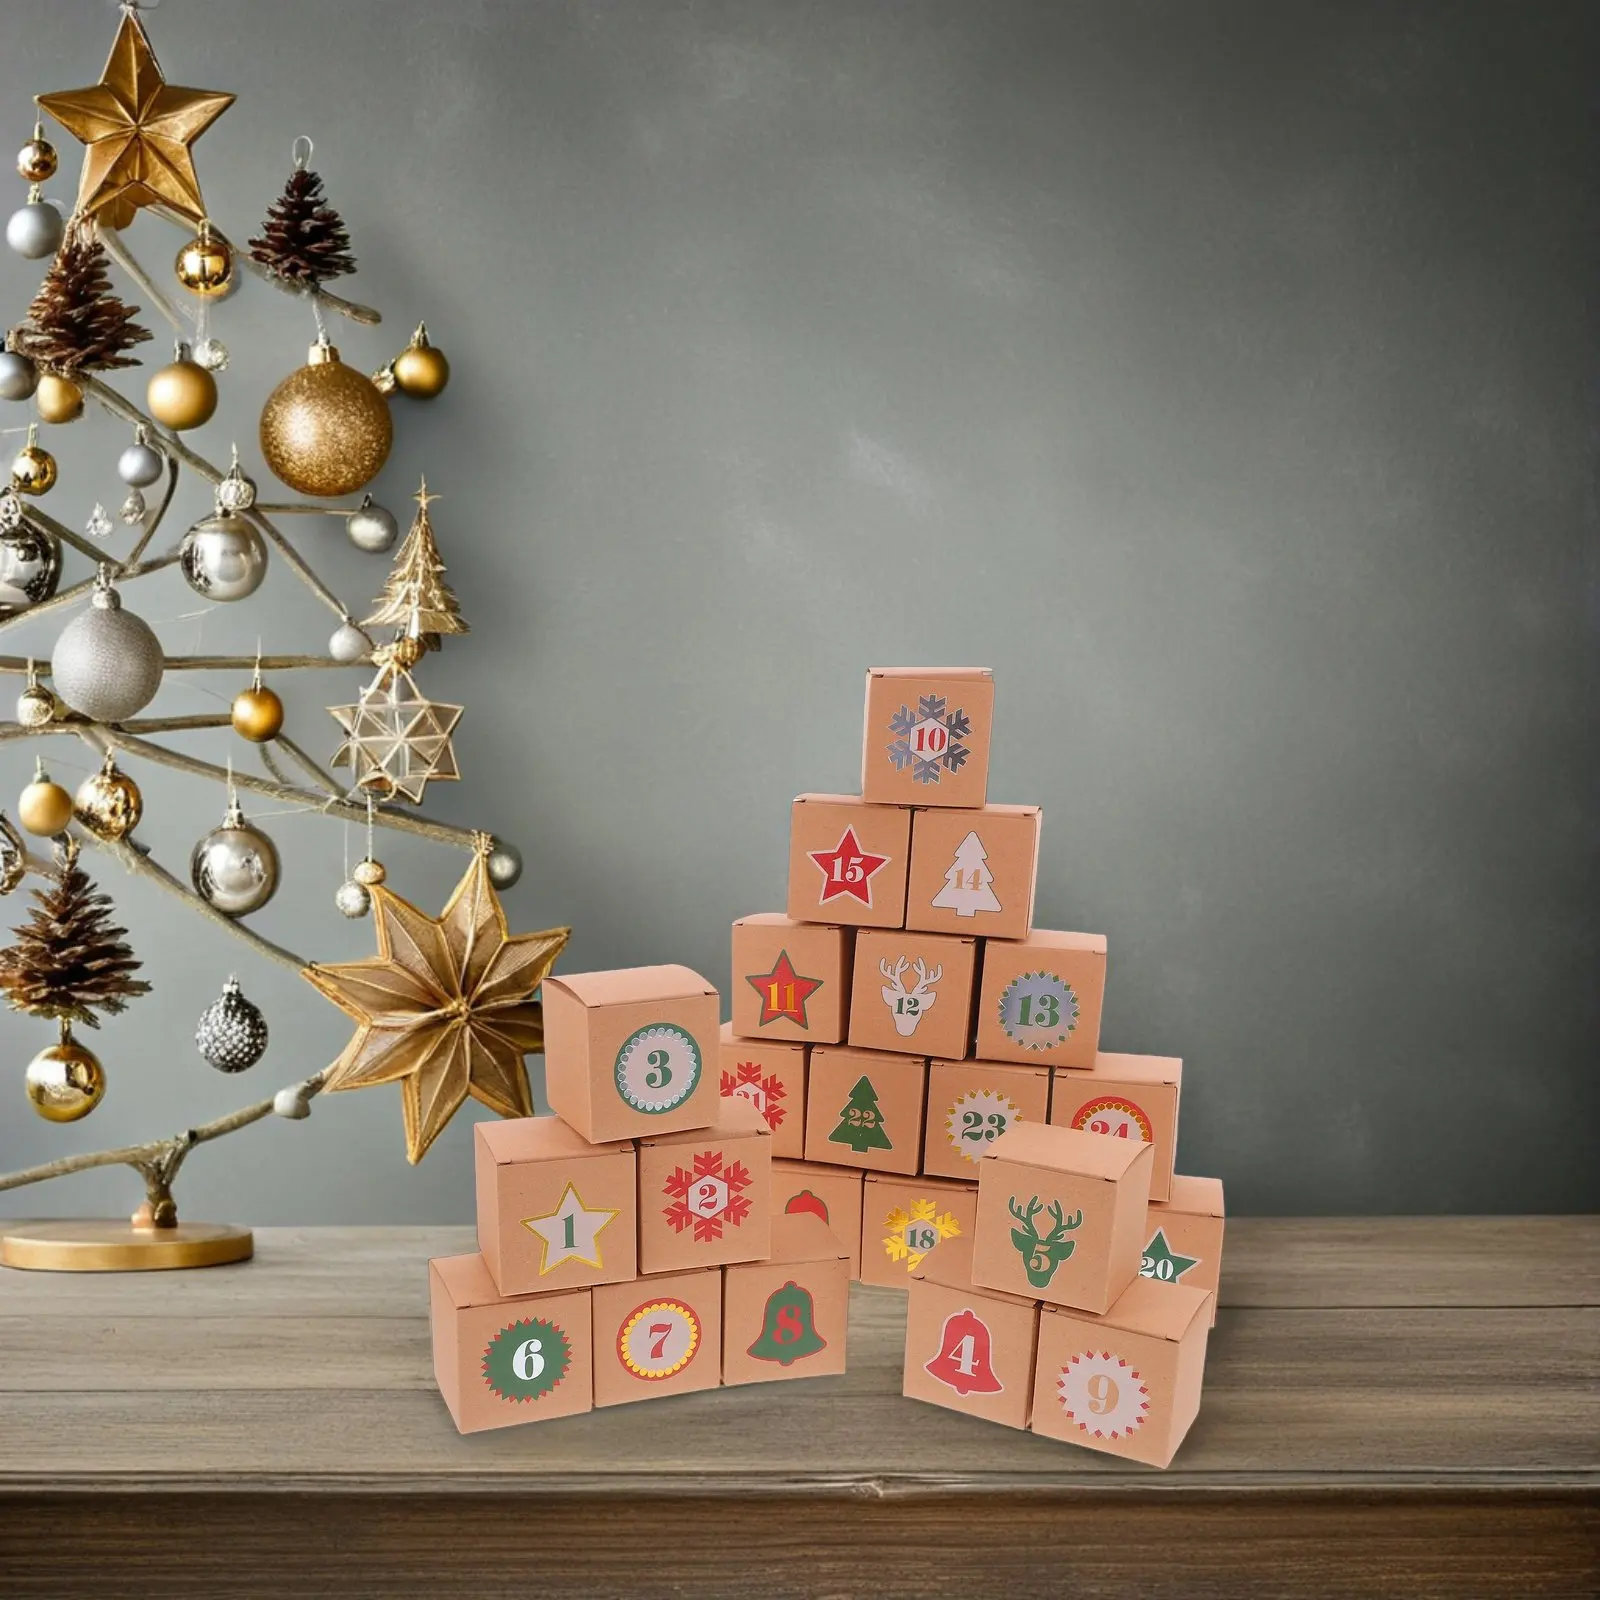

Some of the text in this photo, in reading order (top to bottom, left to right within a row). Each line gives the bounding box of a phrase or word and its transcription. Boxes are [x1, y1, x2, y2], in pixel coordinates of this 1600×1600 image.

[915, 727, 946, 752] 10
[829, 856, 865, 882] 15
[951, 869, 983, 891] 14
[767, 983, 796, 1013] 11
[894, 997, 920, 1015] 12
[1014, 997, 1060, 1028] 13
[645, 1050, 672, 1088] 3
[847, 1109, 877, 1127] 22
[961, 1111, 1006, 1142] 23
[698, 1184, 718, 1210] 2
[560, 1213, 579, 1249] 1
[907, 1228, 935, 1249] 18
[1030, 1246, 1051, 1272] 5
[1138, 1256, 1174, 1280] 20
[771, 1304, 801, 1344] 8
[648, 1323, 674, 1359] 7
[948, 1335, 980, 1377] 4
[512, 1339, 545, 1380] 6
[1087, 1374, 1120, 1415] 9
